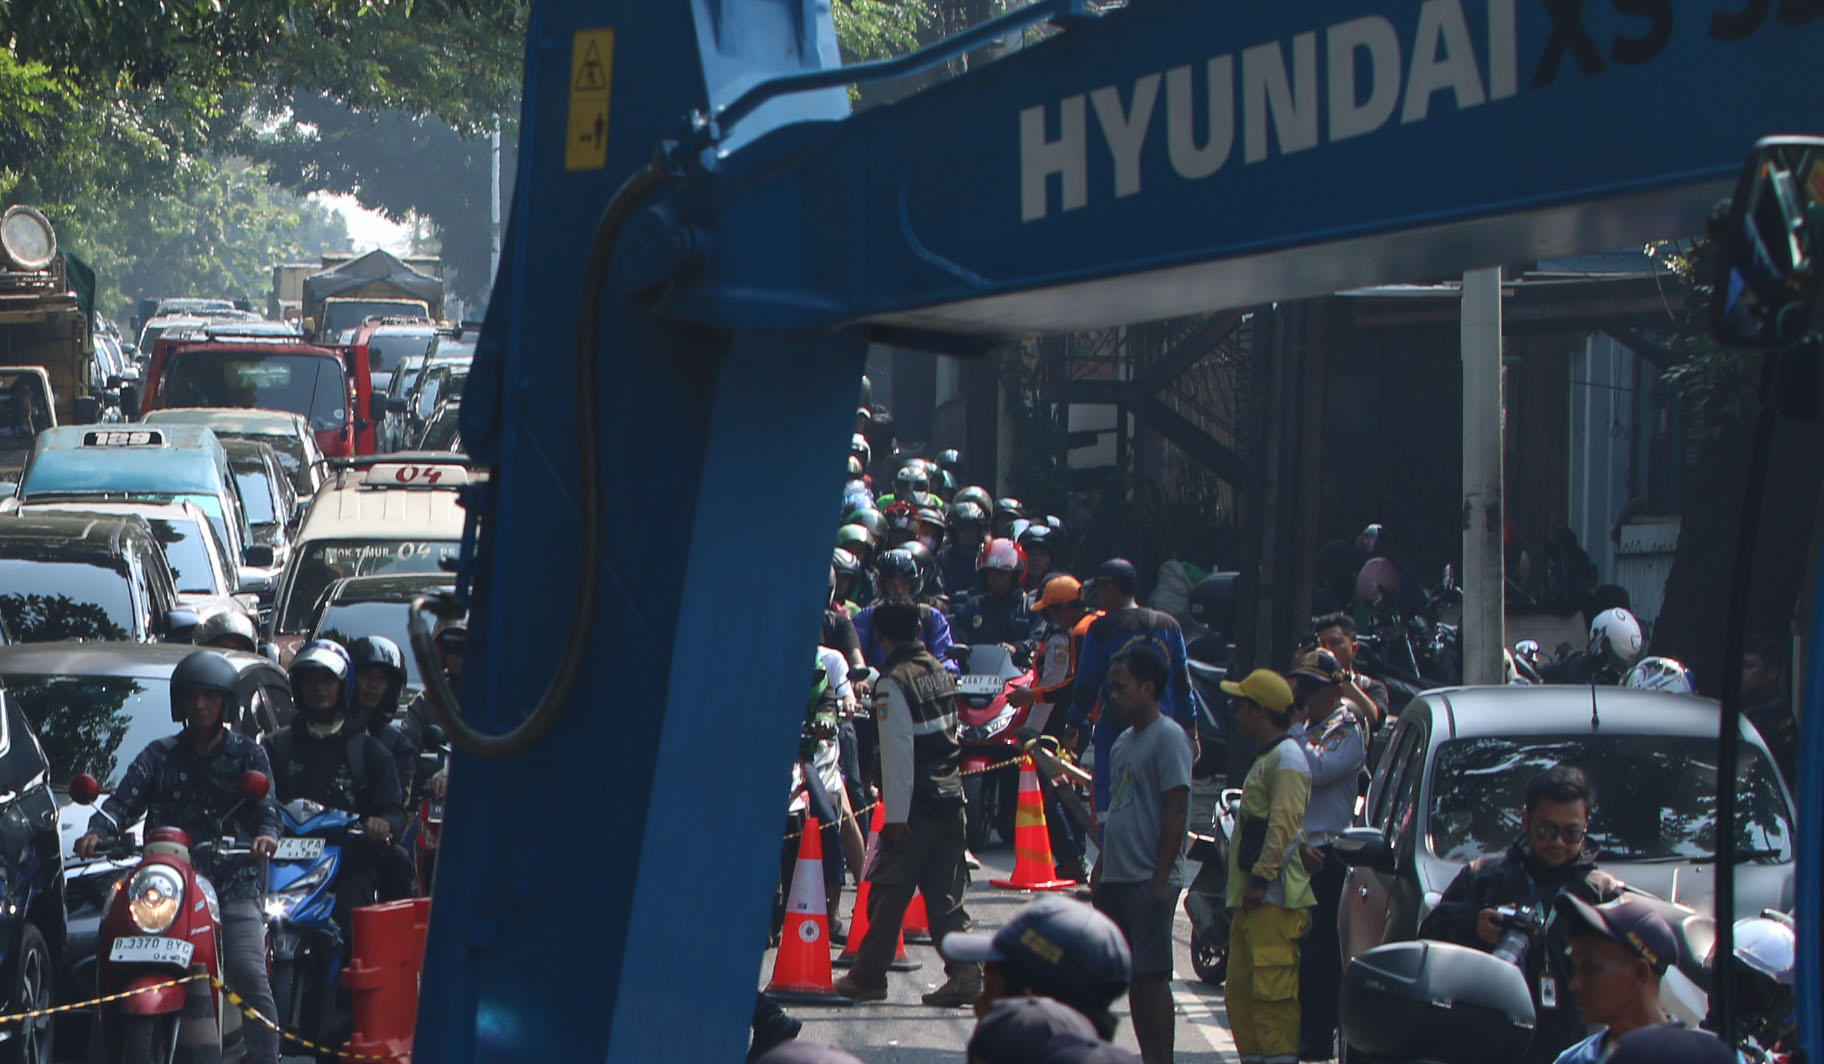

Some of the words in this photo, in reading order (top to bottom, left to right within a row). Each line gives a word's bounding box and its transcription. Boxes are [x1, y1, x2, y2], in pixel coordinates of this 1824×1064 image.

[1019, 0, 1518, 222] HYUNDAI
[395, 466, 442, 484] 04
[397, 541, 431, 560] 04
